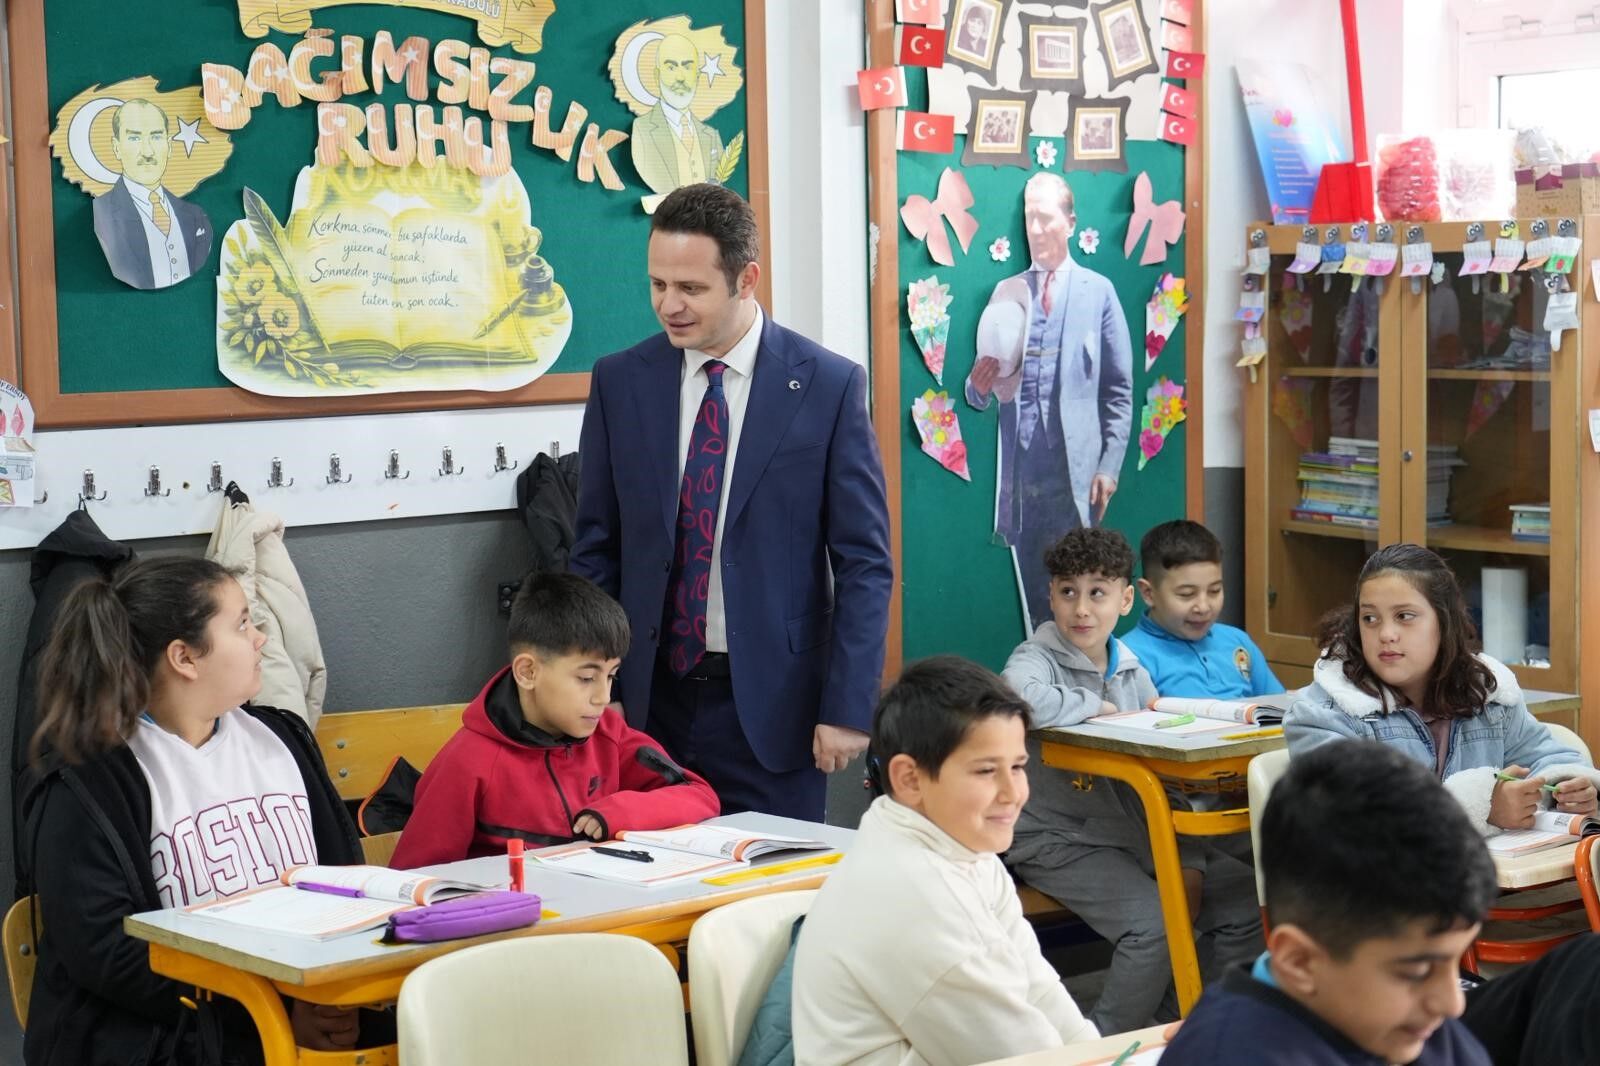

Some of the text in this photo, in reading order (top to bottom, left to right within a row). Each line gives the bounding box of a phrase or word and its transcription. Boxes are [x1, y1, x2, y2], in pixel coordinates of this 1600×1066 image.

[317, 102, 513, 177] RUHU
[398, 226, 409, 242] bu
[342, 240, 374, 262] yüzen
[376, 244, 388, 256] al
